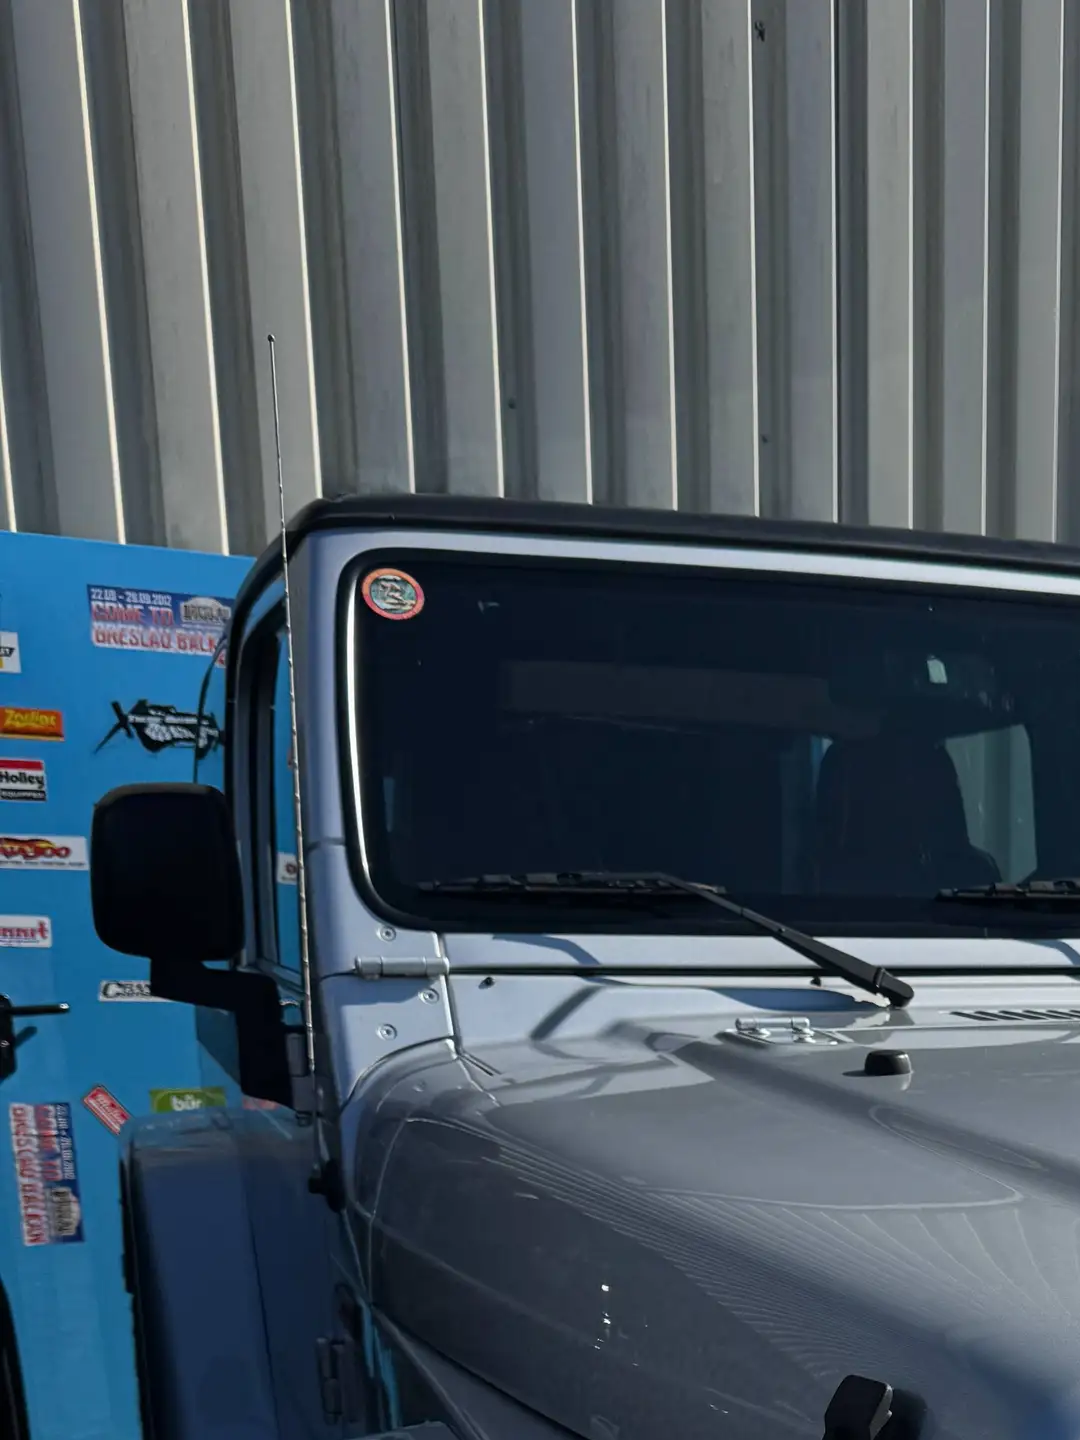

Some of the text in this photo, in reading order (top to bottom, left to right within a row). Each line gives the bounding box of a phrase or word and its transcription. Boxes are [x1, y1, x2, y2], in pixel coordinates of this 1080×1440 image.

[91, 601, 175, 627] COME TO
[94, 623, 172, 649] BRESLAU
